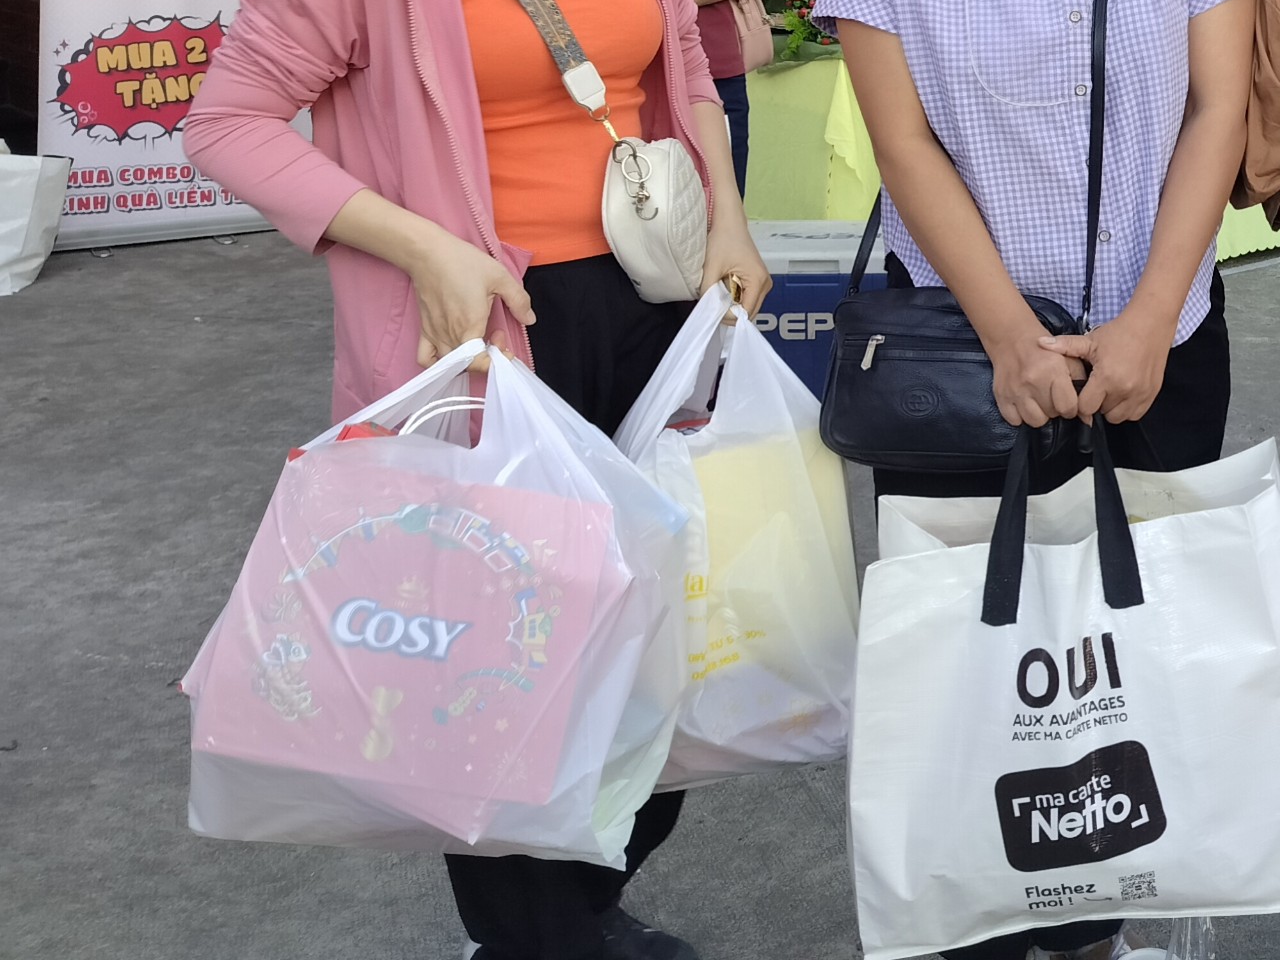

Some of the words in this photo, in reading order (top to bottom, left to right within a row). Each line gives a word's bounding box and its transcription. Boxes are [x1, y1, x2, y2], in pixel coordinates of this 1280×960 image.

[96, 40, 178, 74] MUA
[184, 37, 208, 65] 2
[118, 165, 194, 183] COMBO
[62, 194, 109, 213] INH
[1016, 632, 1122, 709] OUI
[1012, 713, 1044, 727] AUX
[1049, 695, 1126, 727] AVANTAGES
[1011, 731, 1042, 742] AVEC
[1044, 731, 1063, 741] MA
[1065, 719, 1092, 740] CARTE
[1093, 712, 1128, 727] NETTO
[1034, 791, 1065, 809] ma
[1068, 772, 1112, 804] carte
[1030, 794, 1132, 844] Netto
[1024, 881, 1097, 900] Flashez
[1028, 897, 1063, 910] moi
